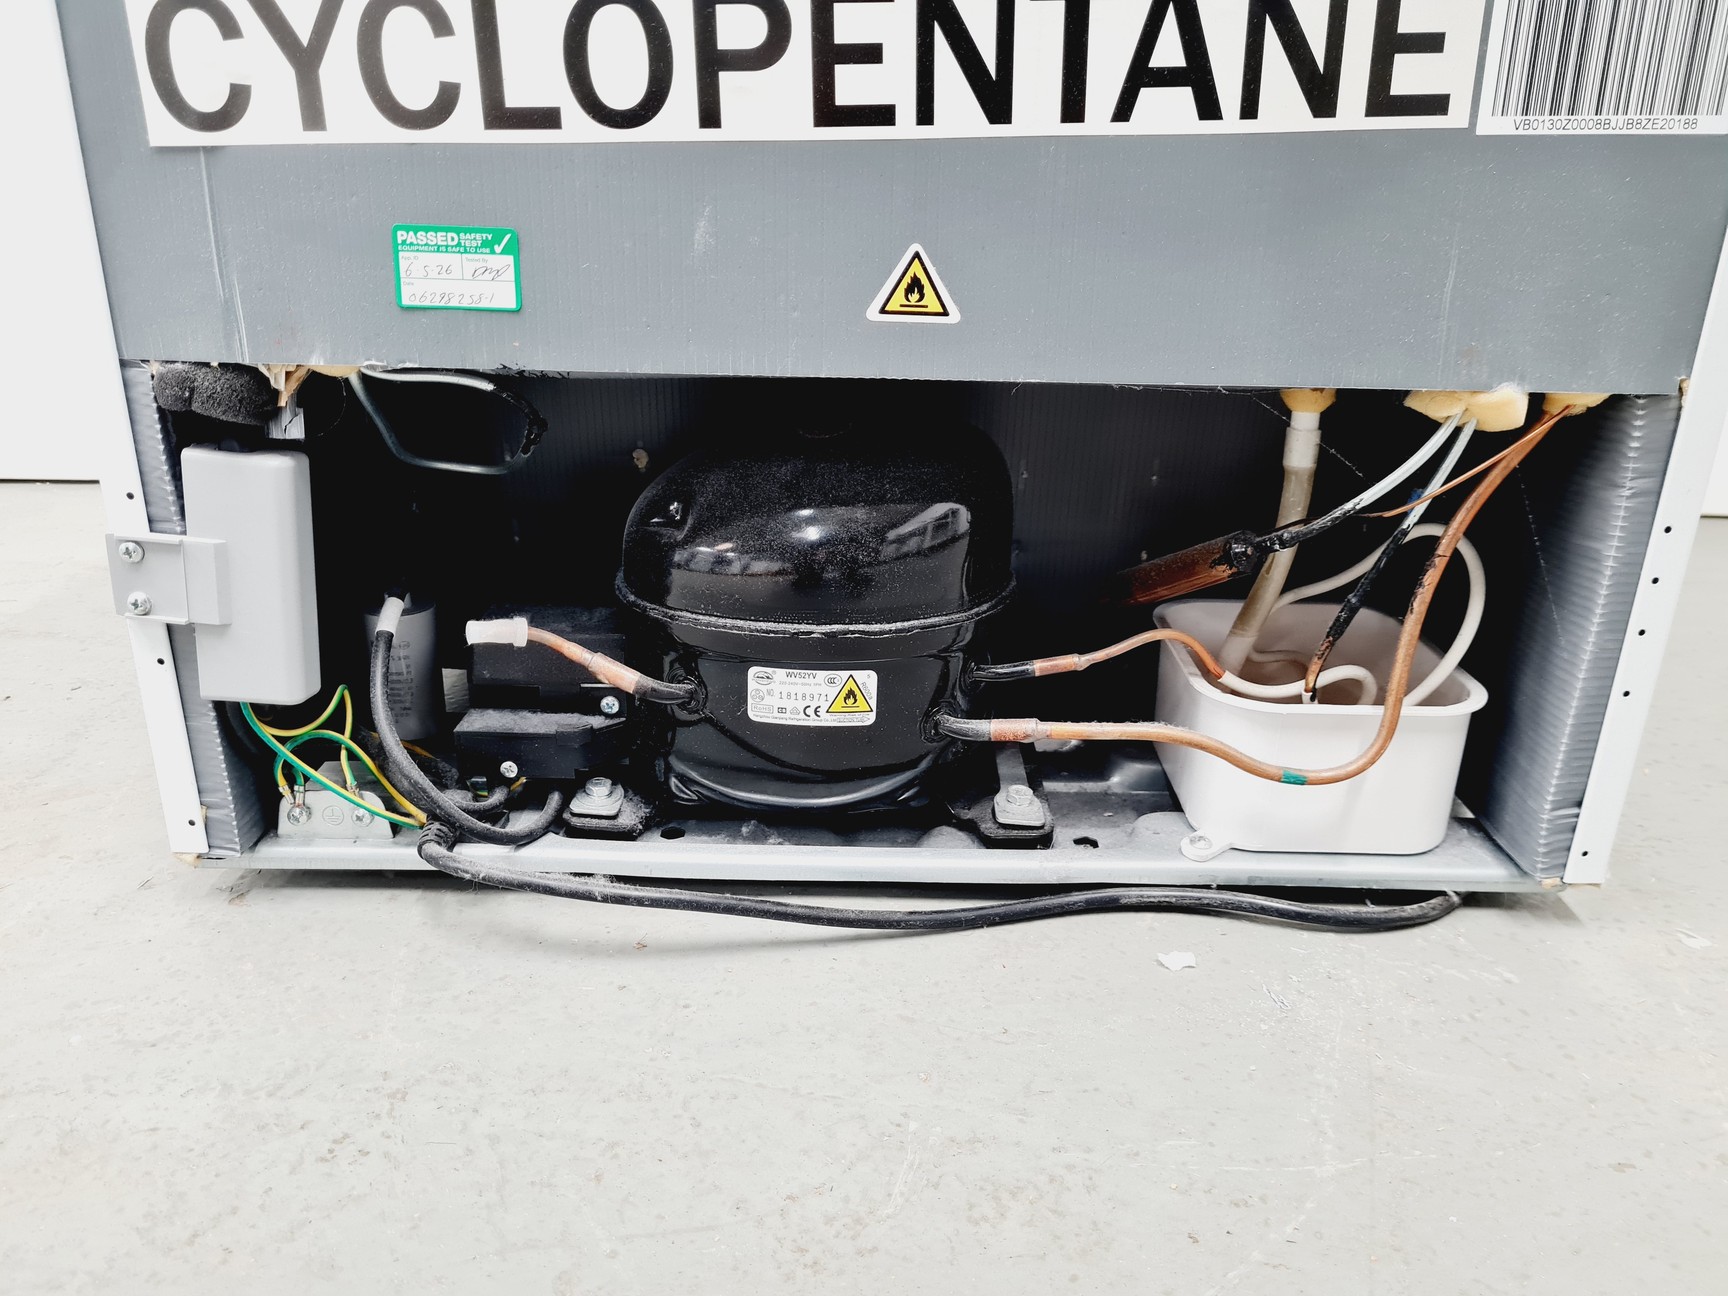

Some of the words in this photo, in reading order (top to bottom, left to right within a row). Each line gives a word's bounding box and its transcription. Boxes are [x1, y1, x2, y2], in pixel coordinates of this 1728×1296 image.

[145, 0, 1450, 132] CYCLOPENTANE
[397, 231, 459, 246] PASSED
[785, 671, 817, 680] WV52YV
